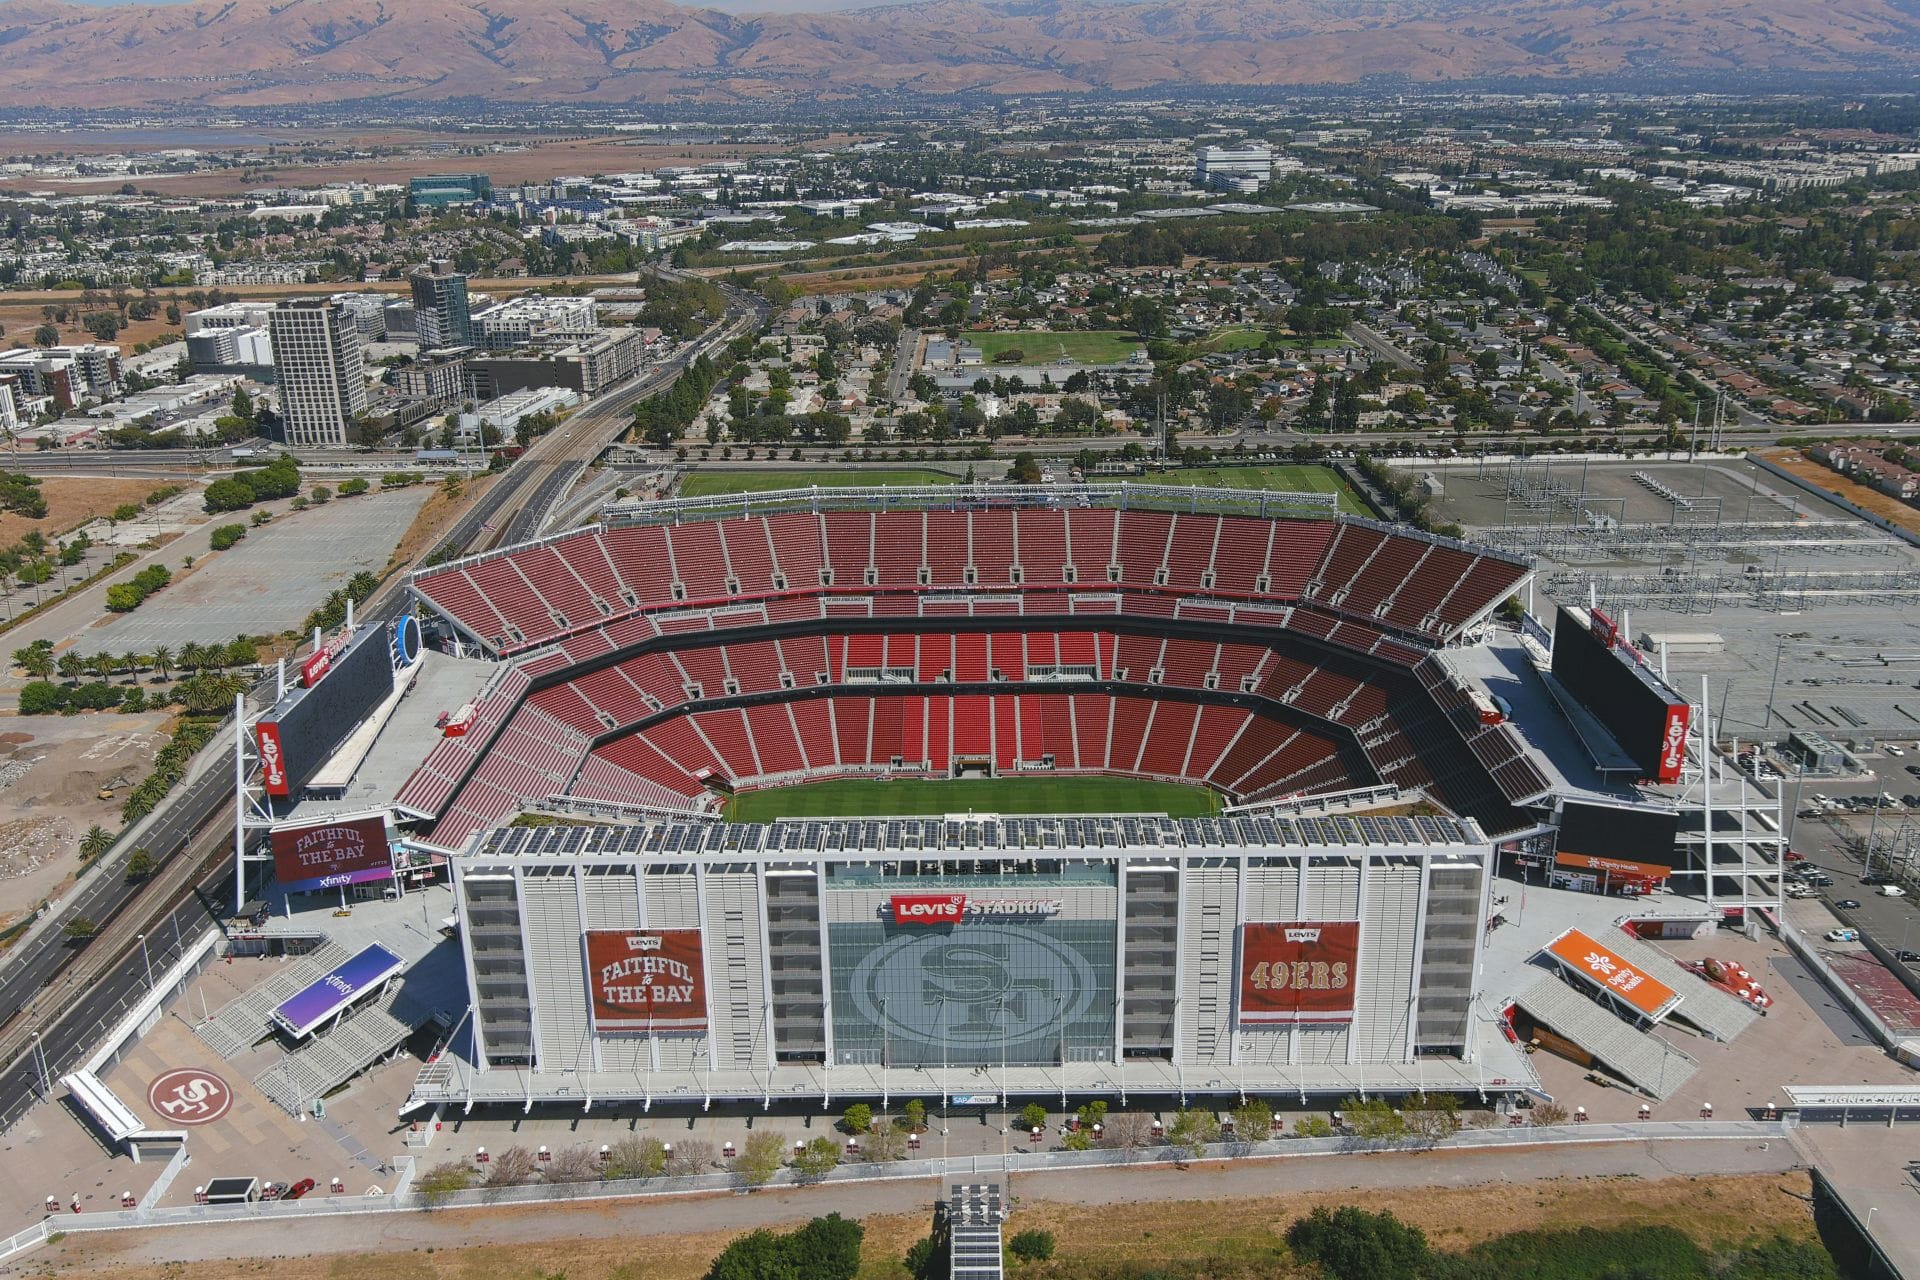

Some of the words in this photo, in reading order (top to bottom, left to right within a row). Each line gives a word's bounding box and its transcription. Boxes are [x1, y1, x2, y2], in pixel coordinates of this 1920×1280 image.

[296, 828, 364, 852] FAITHFUL
[299, 851, 332, 866] THE
[335, 845, 365, 861] BAY
[320, 874, 352, 888] xfinity
[970, 900, 1055, 915] STADIUM
[602, 956, 693, 985] FAITHFUL
[1250, 961, 1348, 989] 49ERS
[1608, 968, 1634, 986] Dignity
[325, 974, 354, 996] xfinity
[1620, 976, 1644, 992] Health
[603, 985, 647, 1003] THE
[651, 985, 694, 1002] BAY
